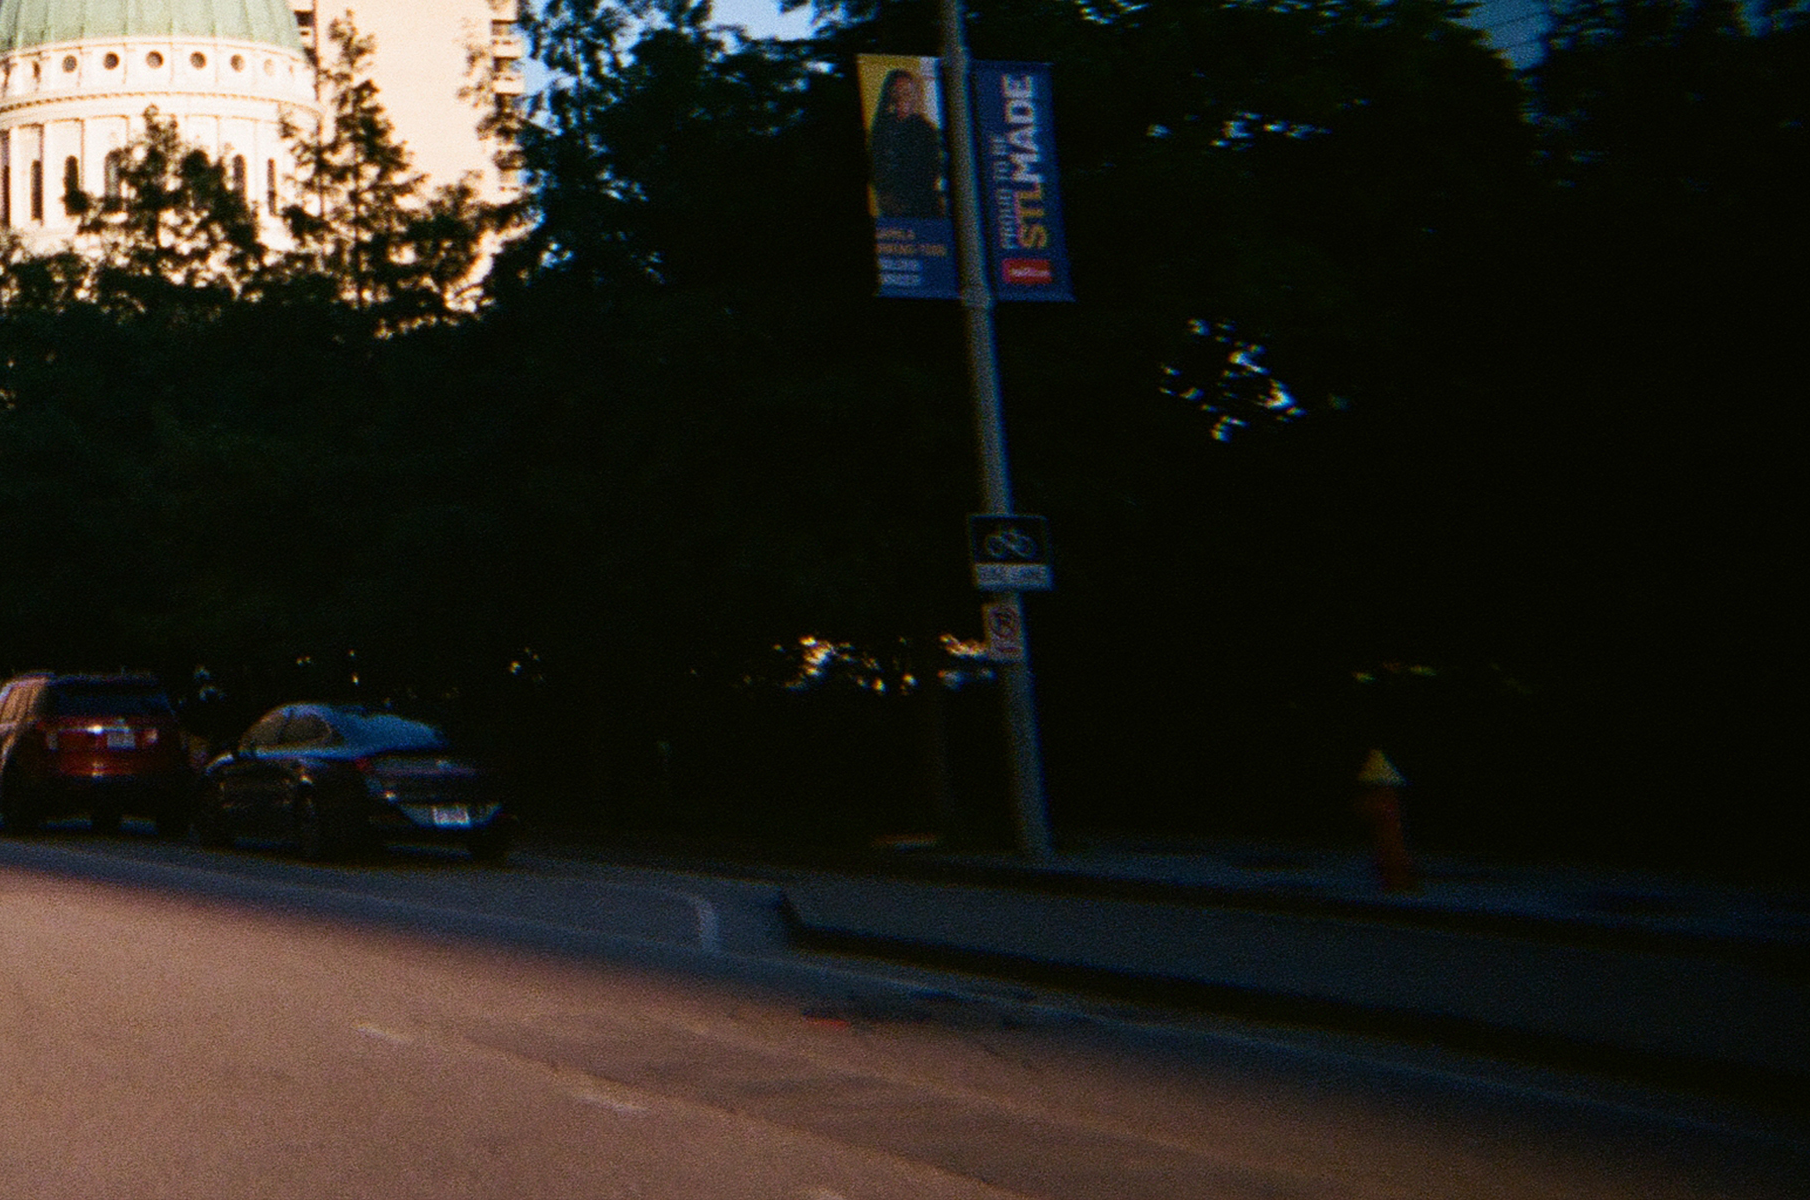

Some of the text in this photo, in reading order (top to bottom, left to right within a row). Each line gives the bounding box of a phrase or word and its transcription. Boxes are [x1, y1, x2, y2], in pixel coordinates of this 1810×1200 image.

[989, 134, 1016, 249] PROUD TO BE
